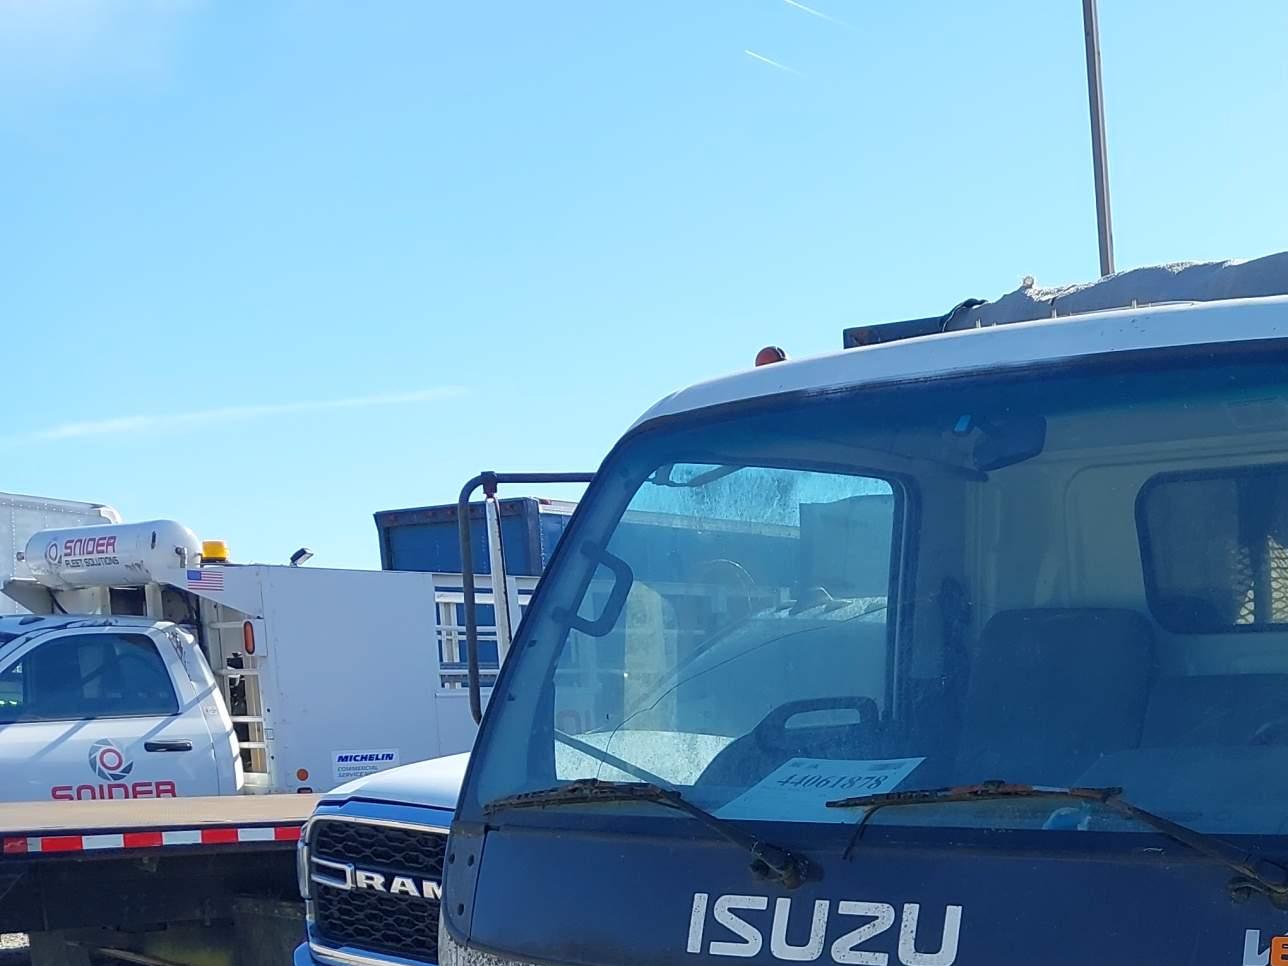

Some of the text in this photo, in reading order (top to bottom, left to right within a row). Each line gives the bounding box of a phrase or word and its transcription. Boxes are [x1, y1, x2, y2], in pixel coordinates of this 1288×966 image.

[64, 535, 117, 557] SNIDER
[65, 556, 120, 568] FLEET SOLUTIONS
[337, 753, 395, 763] MICHELIN
[51, 781, 177, 801] SNIDER
[777, 774, 889, 791] 44061878
